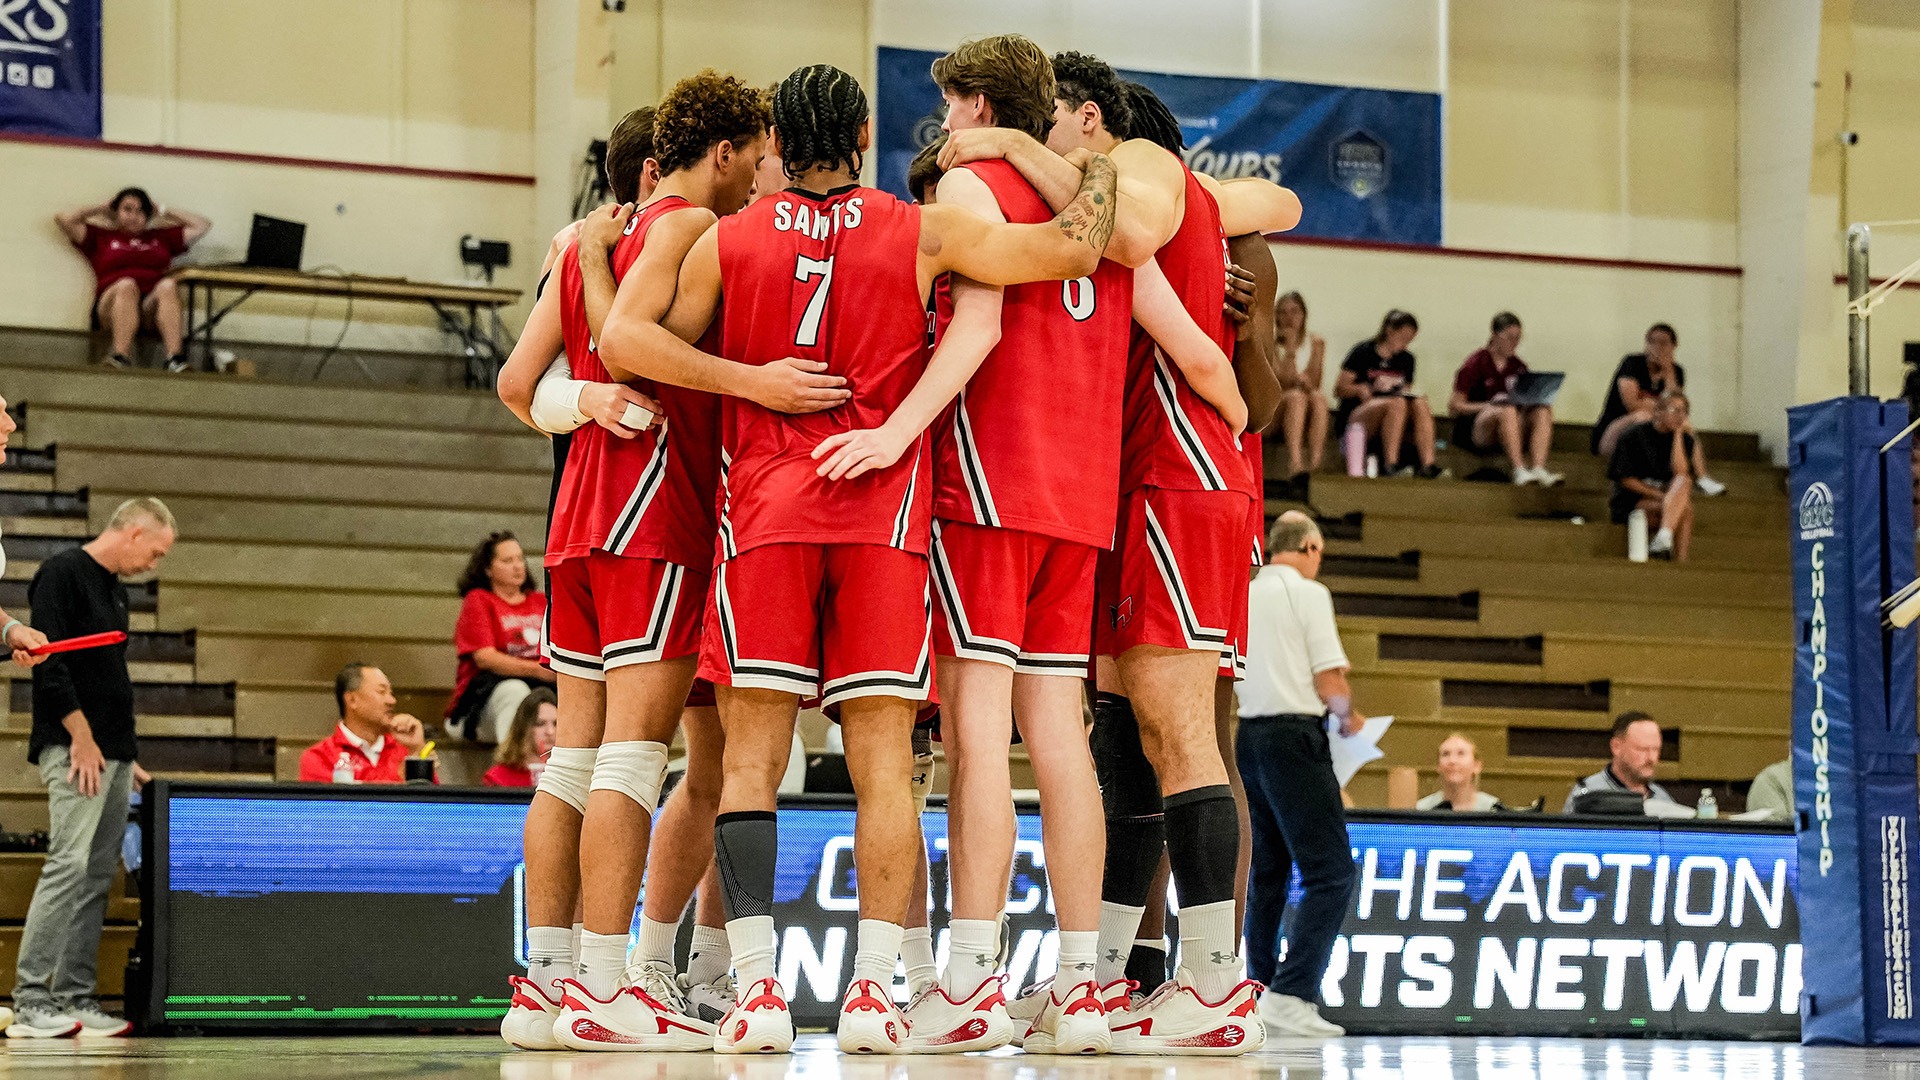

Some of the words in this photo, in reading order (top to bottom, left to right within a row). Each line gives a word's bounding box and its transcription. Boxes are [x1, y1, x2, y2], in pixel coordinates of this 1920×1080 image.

[774, 197, 864, 242] SANTS
[794, 253, 835, 347] 7
[1811, 542, 1834, 877] CHAMPIONSHIP
[1351, 848, 1473, 922] HE
[1484, 850, 1787, 928] ACTION
